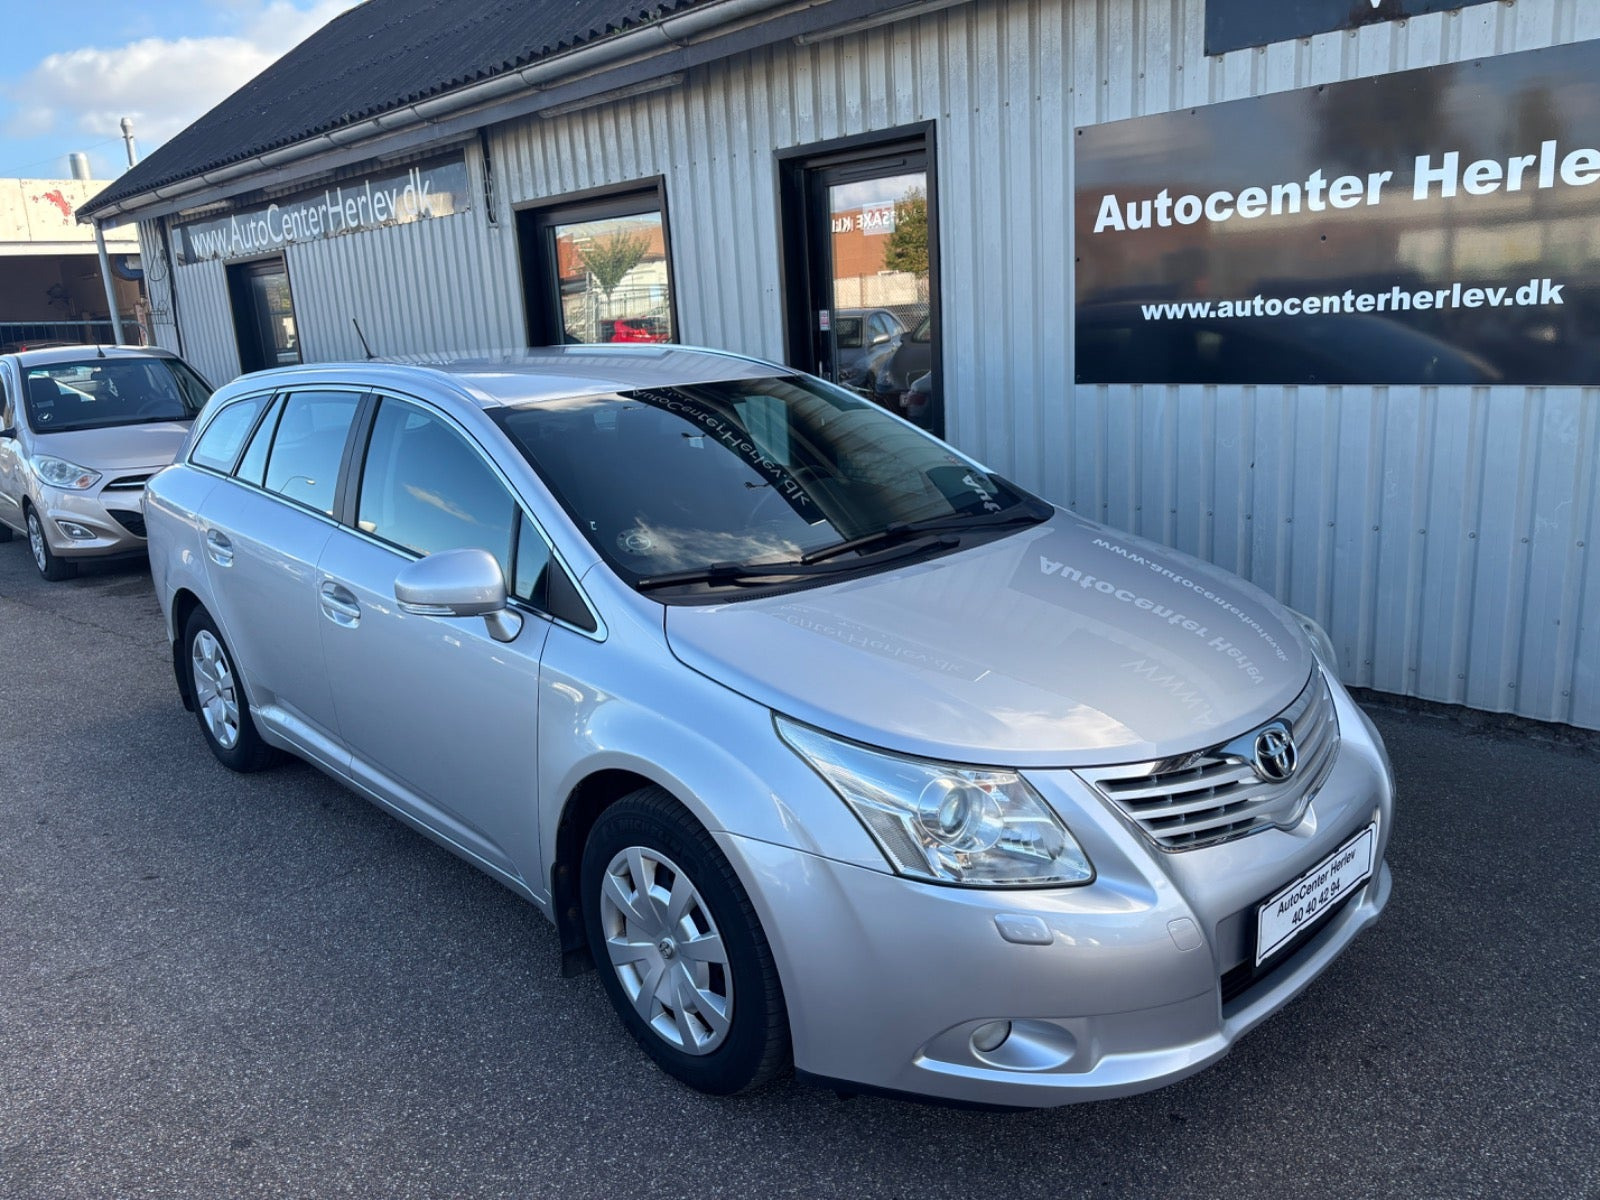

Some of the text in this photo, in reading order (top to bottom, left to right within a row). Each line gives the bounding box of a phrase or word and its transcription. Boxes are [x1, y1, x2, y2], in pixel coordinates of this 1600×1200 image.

[1093, 140, 1600, 233] Autocenter Herle
[1141, 278, 1565, 320] www.autocenterherlev.dk
[1277, 848, 1357, 917] AutoCenter Herlev
[1292, 878, 1341, 924] 40 40 42 94
